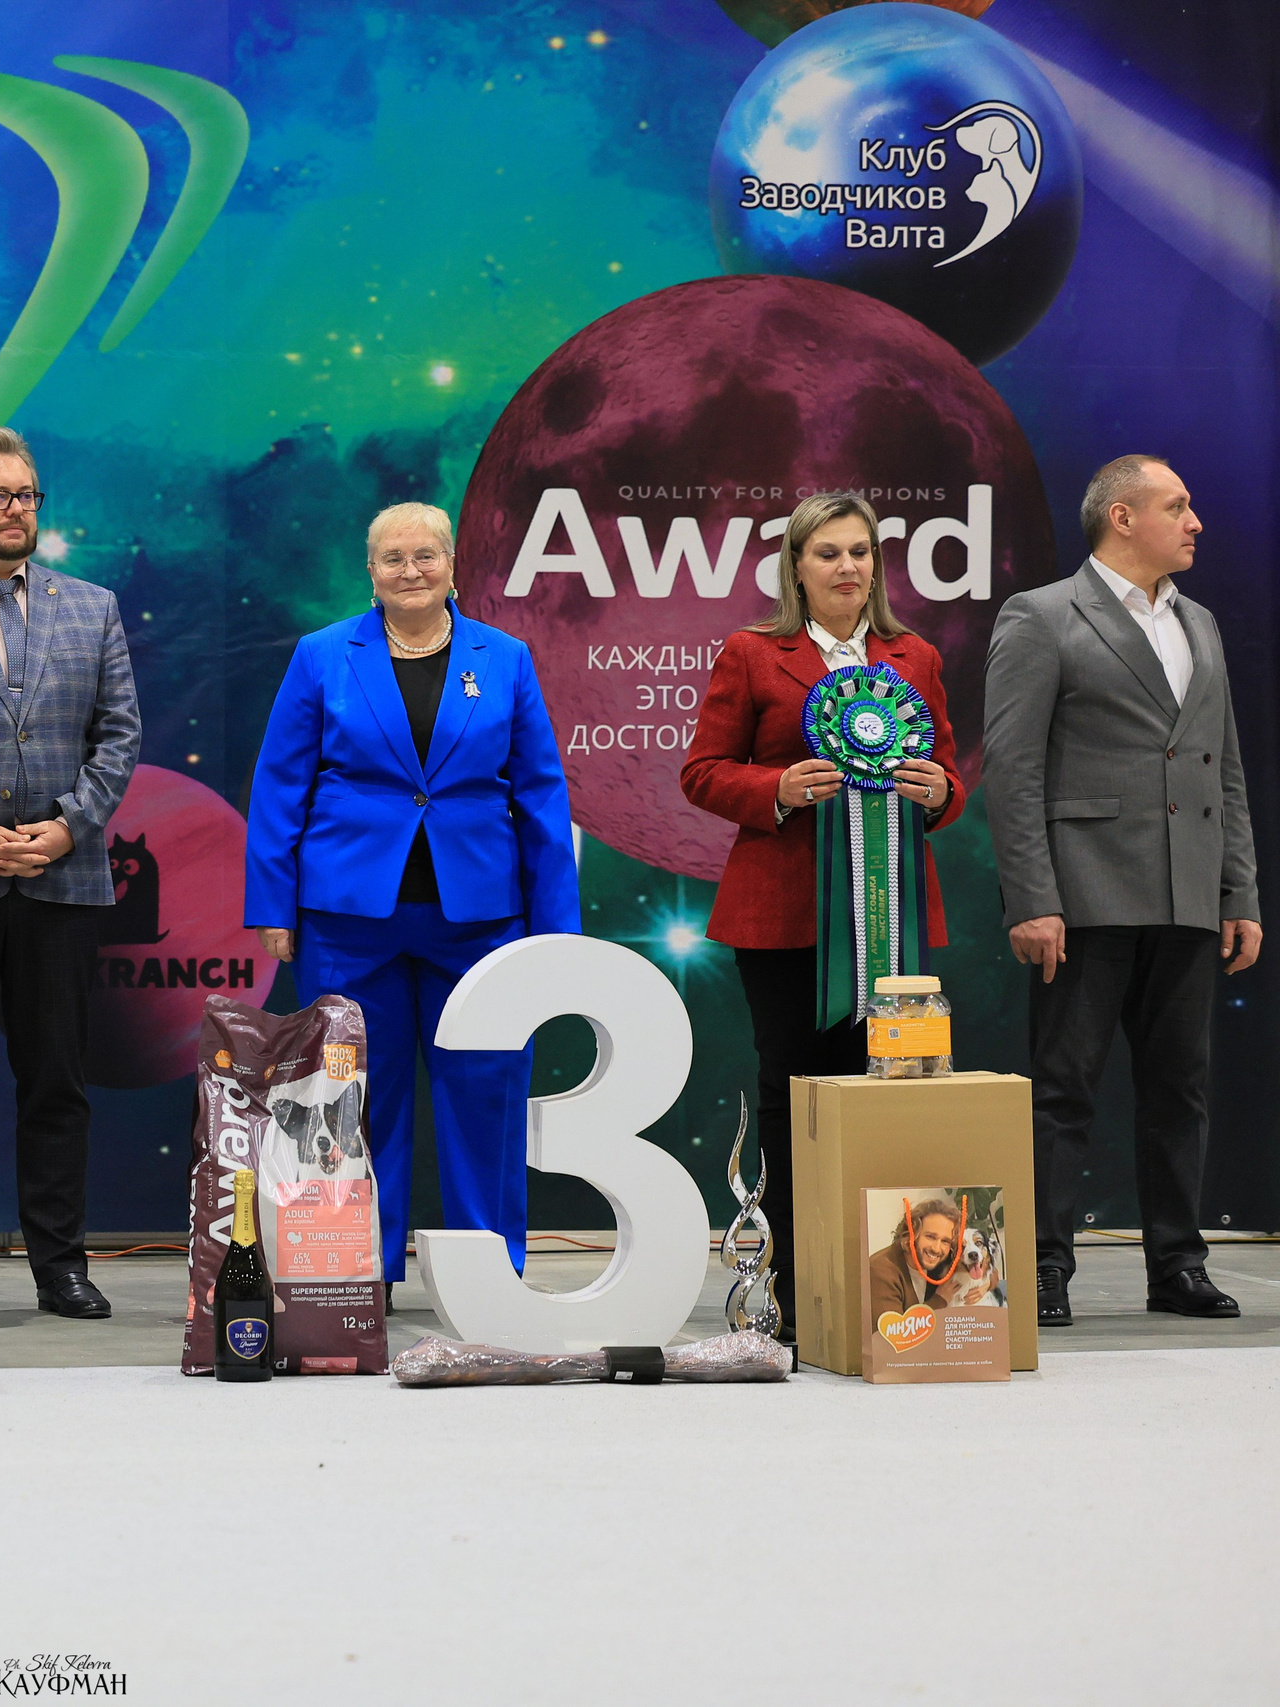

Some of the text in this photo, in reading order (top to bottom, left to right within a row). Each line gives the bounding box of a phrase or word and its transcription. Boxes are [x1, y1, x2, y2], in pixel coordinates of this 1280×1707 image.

[861, 139, 947, 177] Клуб
[741, 178, 946, 214] Заводчиков
[846, 219, 946, 249] Валта
[618, 485, 723, 500] QUALITY
[735, 486, 783, 500] FOR
[503, 484, 992, 601] Awd
[588, 639, 725, 676] КАЖДЫЙ
[636, 685, 698, 710] ЭТО
[869, 875, 877, 912] СОБАКА
[878, 888, 886, 941] ВЫСТАВКИ
[327, 1047, 353, 1062] 100%
[329, 1061, 353, 1078] BIO
[414, 933, 710, 1349] 3
[209, 1072, 251, 1247] Award
[285, 1210, 313, 1218] ADULT
[307, 1232, 340, 1240] TURKEY
[293, 1252, 365, 1264] 65% 0% 0%
[342, 1317, 356, 1328] 12
[358, 1321, 366, 1330] kg
[886, 1314, 932, 1338] МНЯМС
